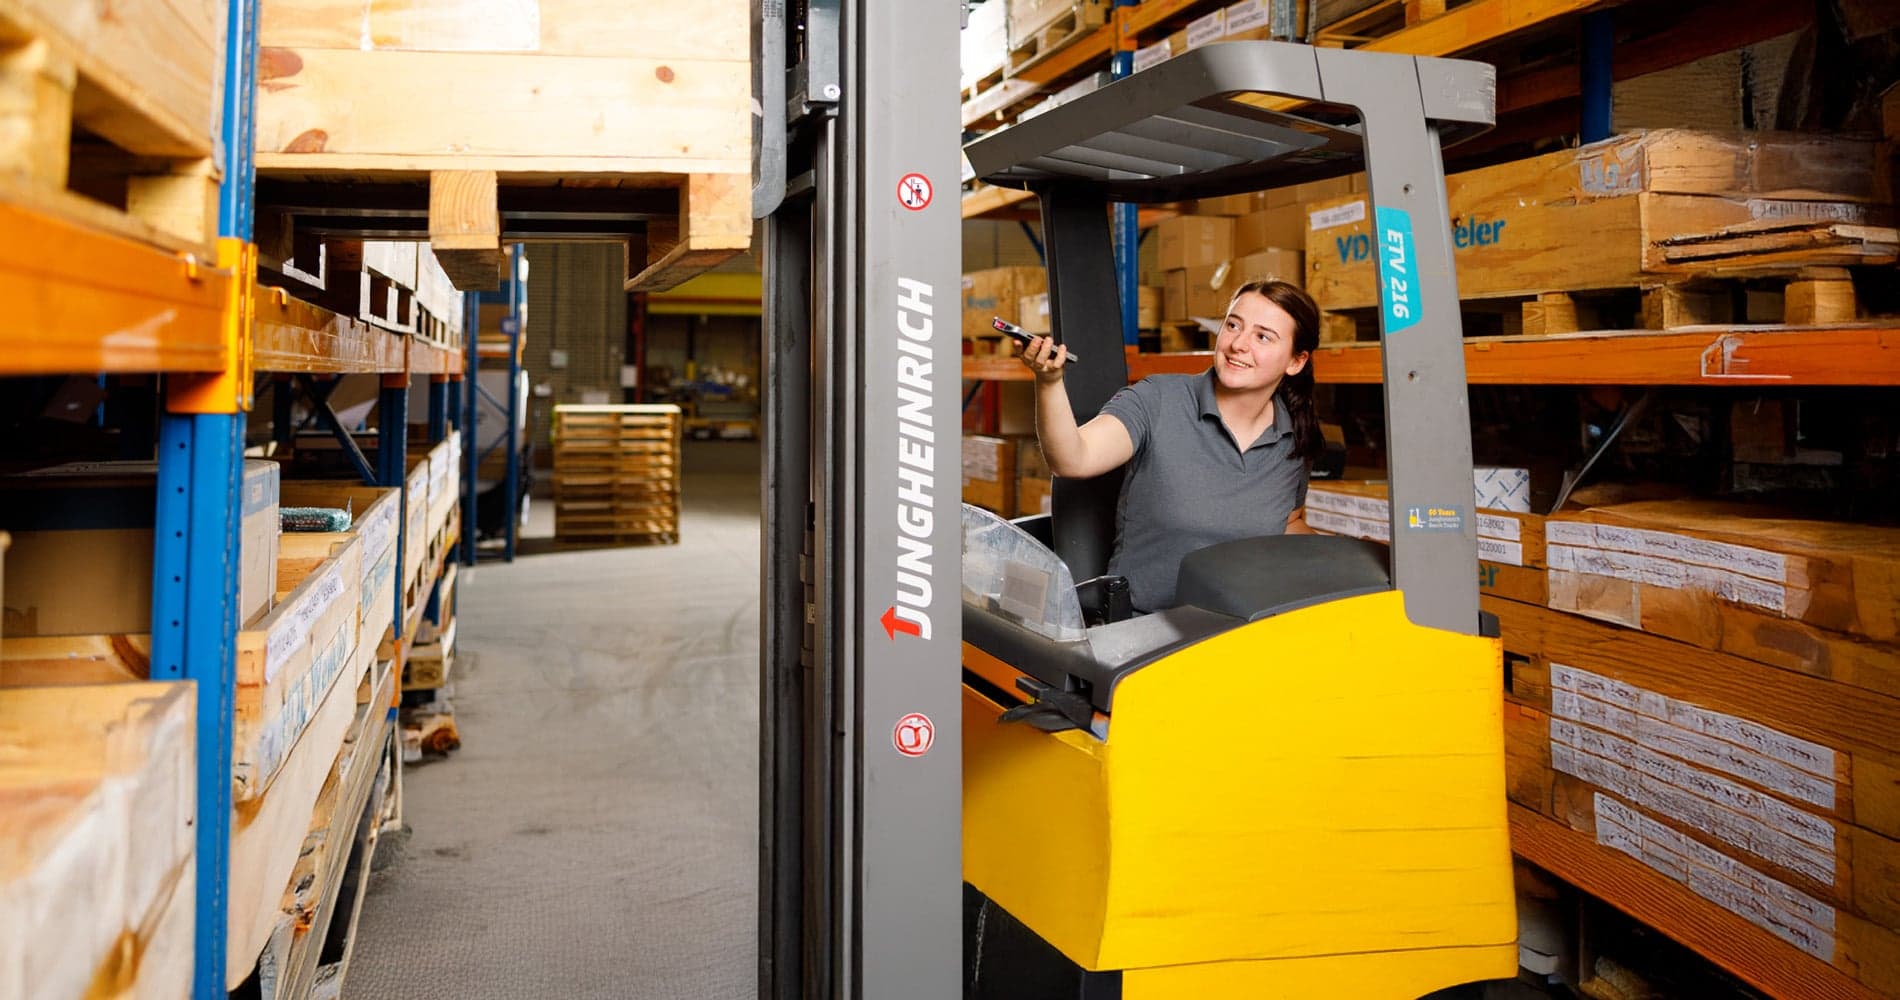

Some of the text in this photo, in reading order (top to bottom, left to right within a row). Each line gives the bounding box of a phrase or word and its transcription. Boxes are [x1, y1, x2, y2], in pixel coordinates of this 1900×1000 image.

[1337, 216, 1506, 265] VD eler
[1387, 228, 1410, 319] ETV 216
[896, 276, 936, 641] JUNGHEINRICH
